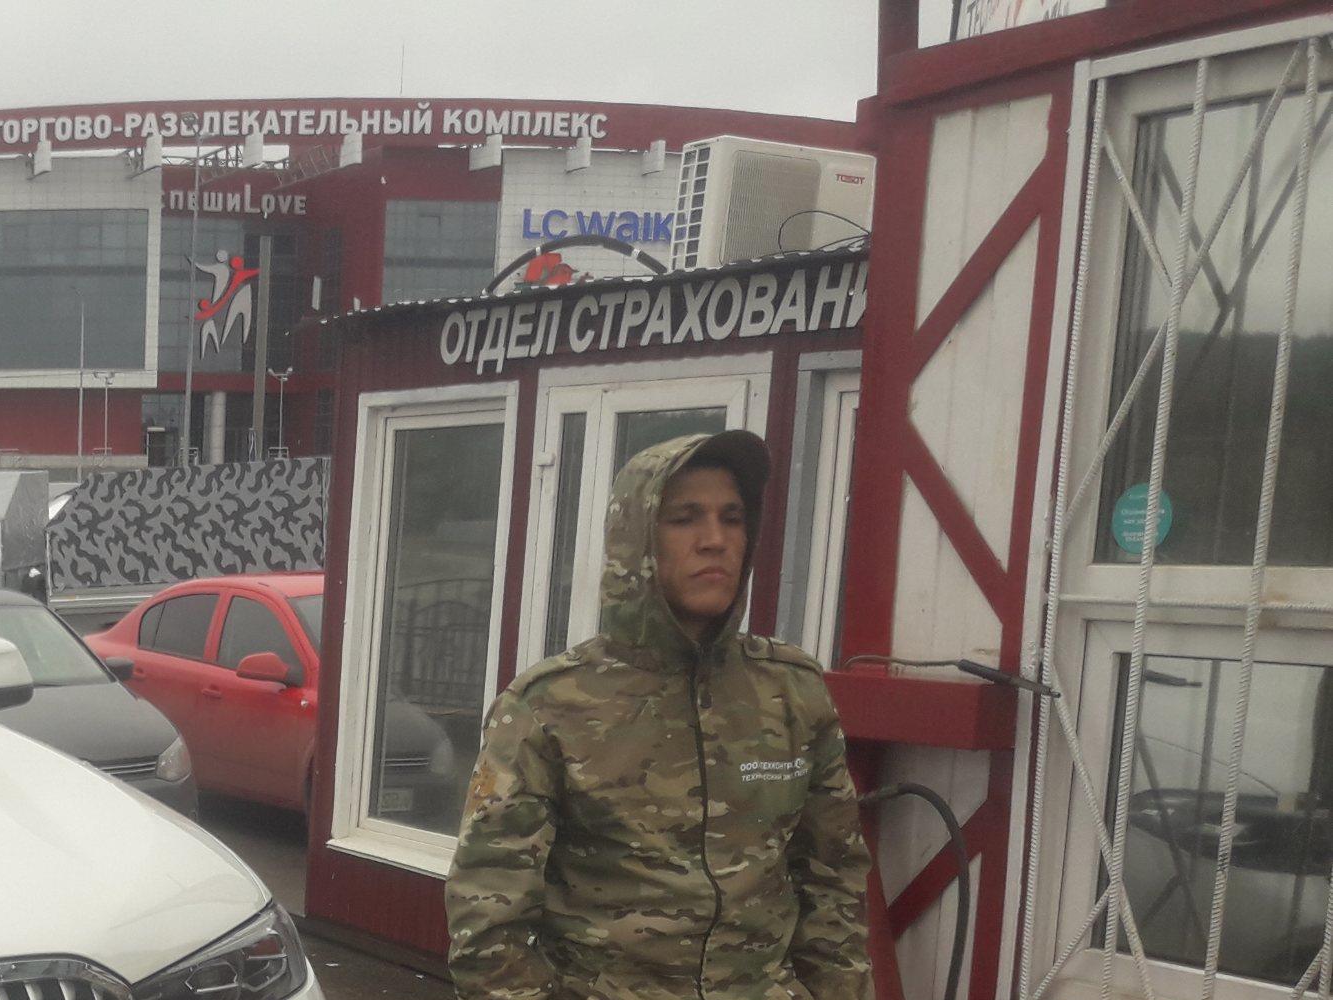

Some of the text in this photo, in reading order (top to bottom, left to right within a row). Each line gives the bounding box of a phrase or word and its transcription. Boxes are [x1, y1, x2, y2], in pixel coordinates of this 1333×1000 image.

[443, 108, 608, 139] КОМПЛЕКС
[522, 208, 568, 240] LC
[440, 300, 562, 376] ОТДЕЛ
[740, 761, 758, 772] ООО
